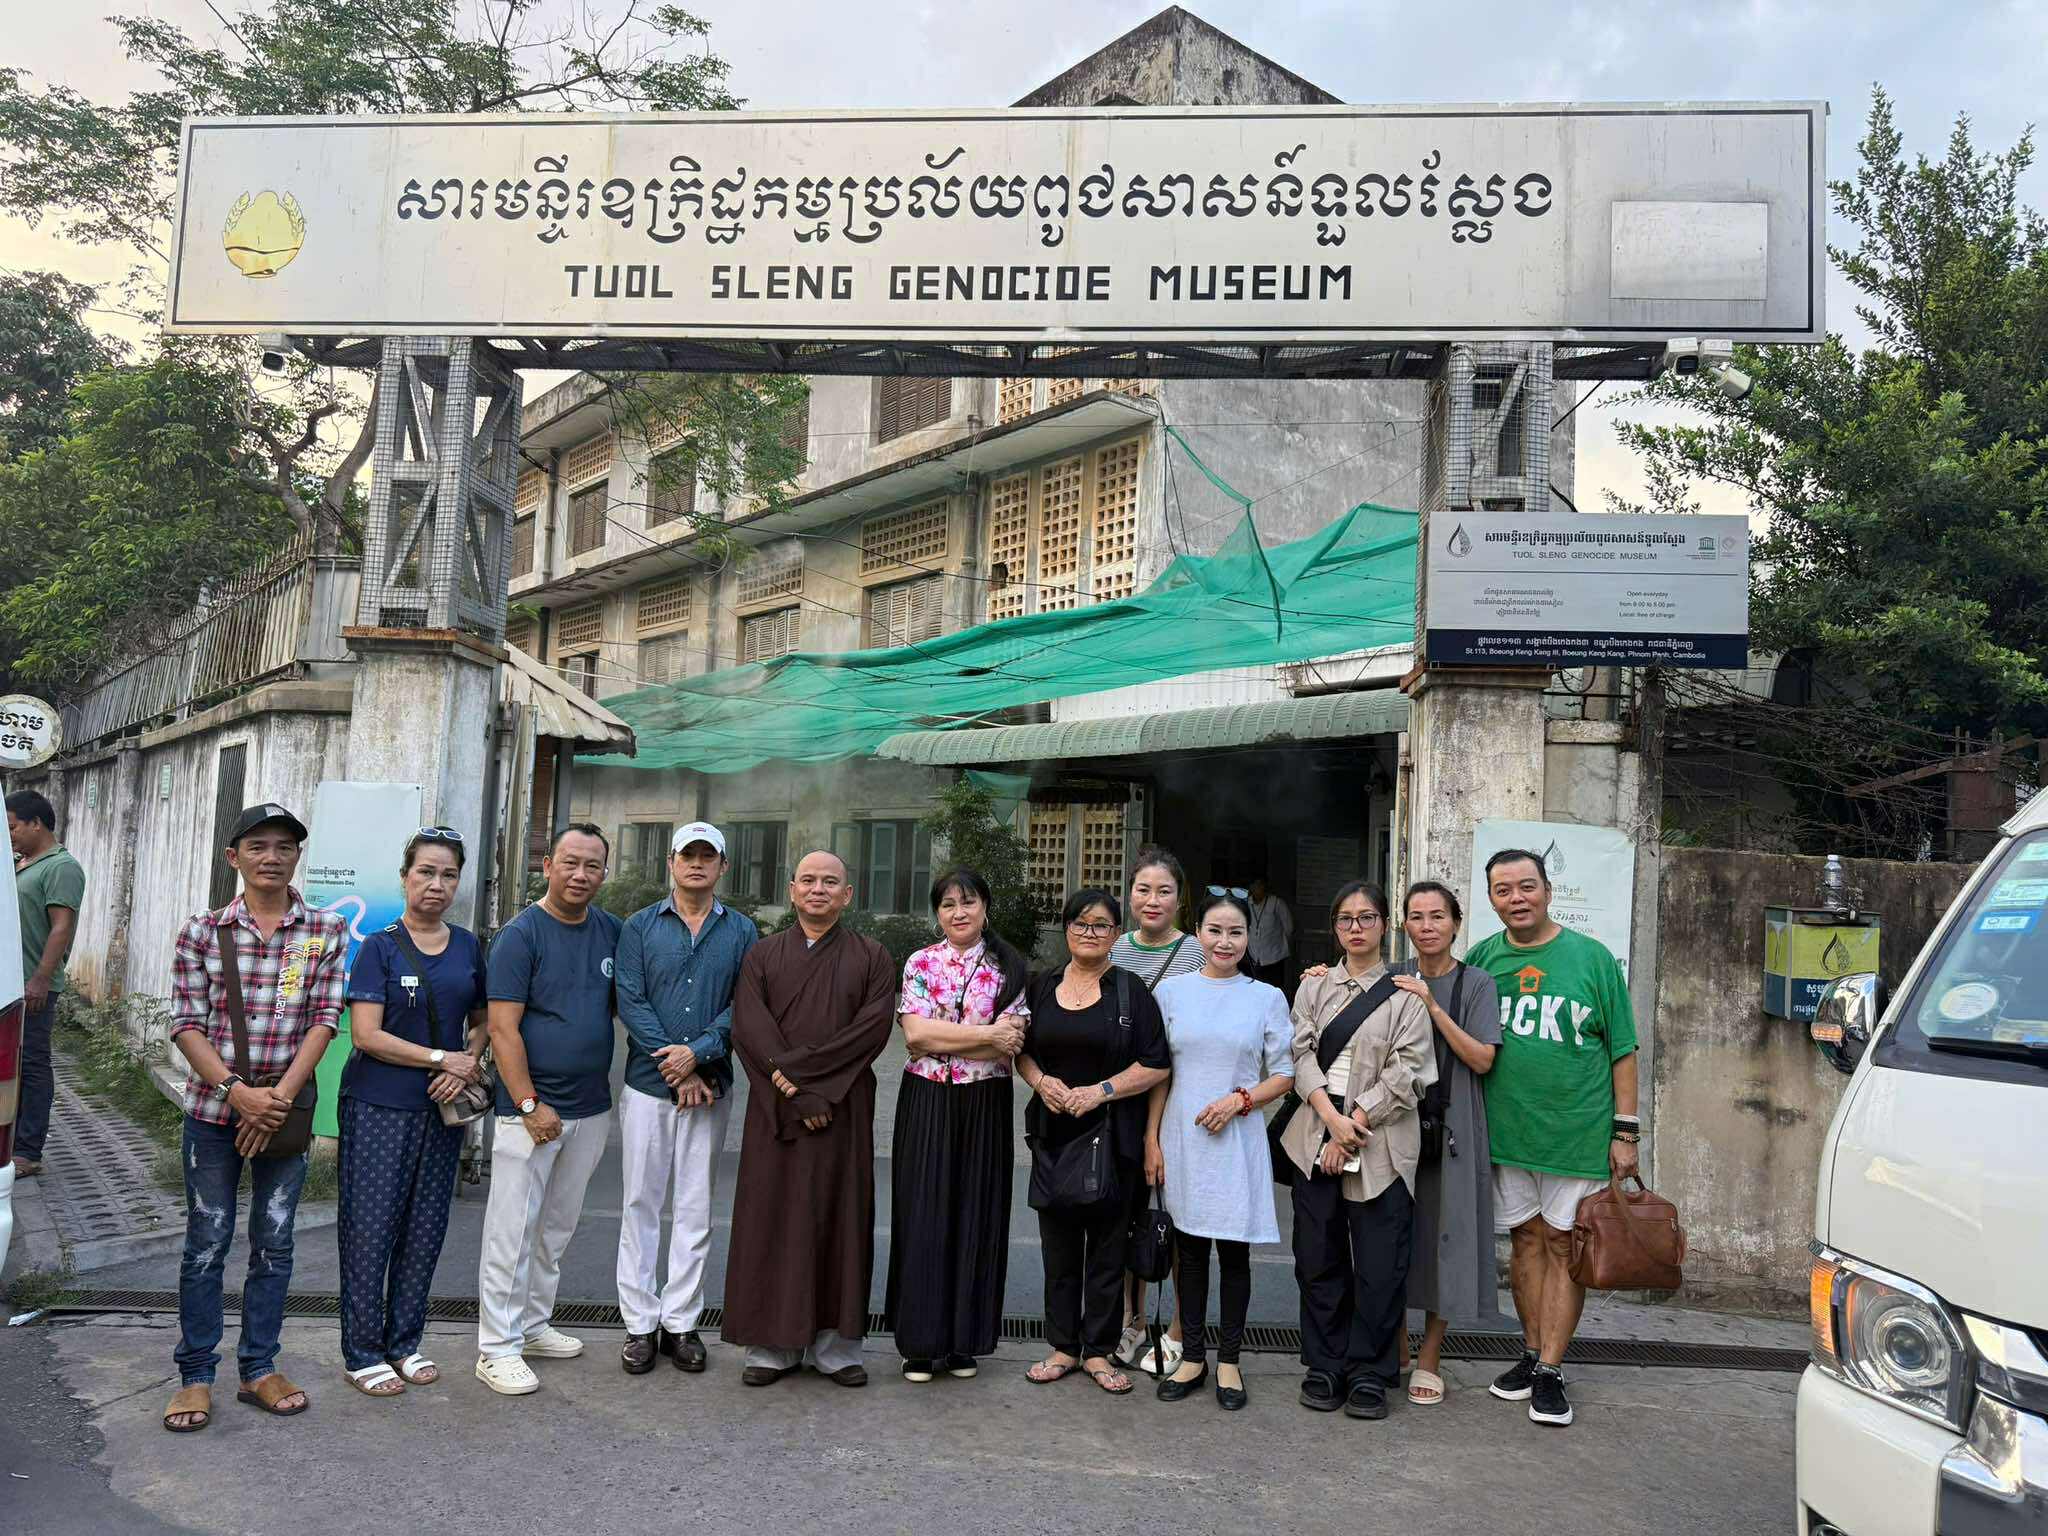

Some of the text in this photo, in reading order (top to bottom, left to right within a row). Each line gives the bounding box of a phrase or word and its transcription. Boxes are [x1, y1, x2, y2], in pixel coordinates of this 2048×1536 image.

[565, 265, 1352, 300] TUOL SLENG GENOCIDE MUSEUM
[1512, 551, 1658, 560] TUOL SLENG GENOCIDE MUSEUM
